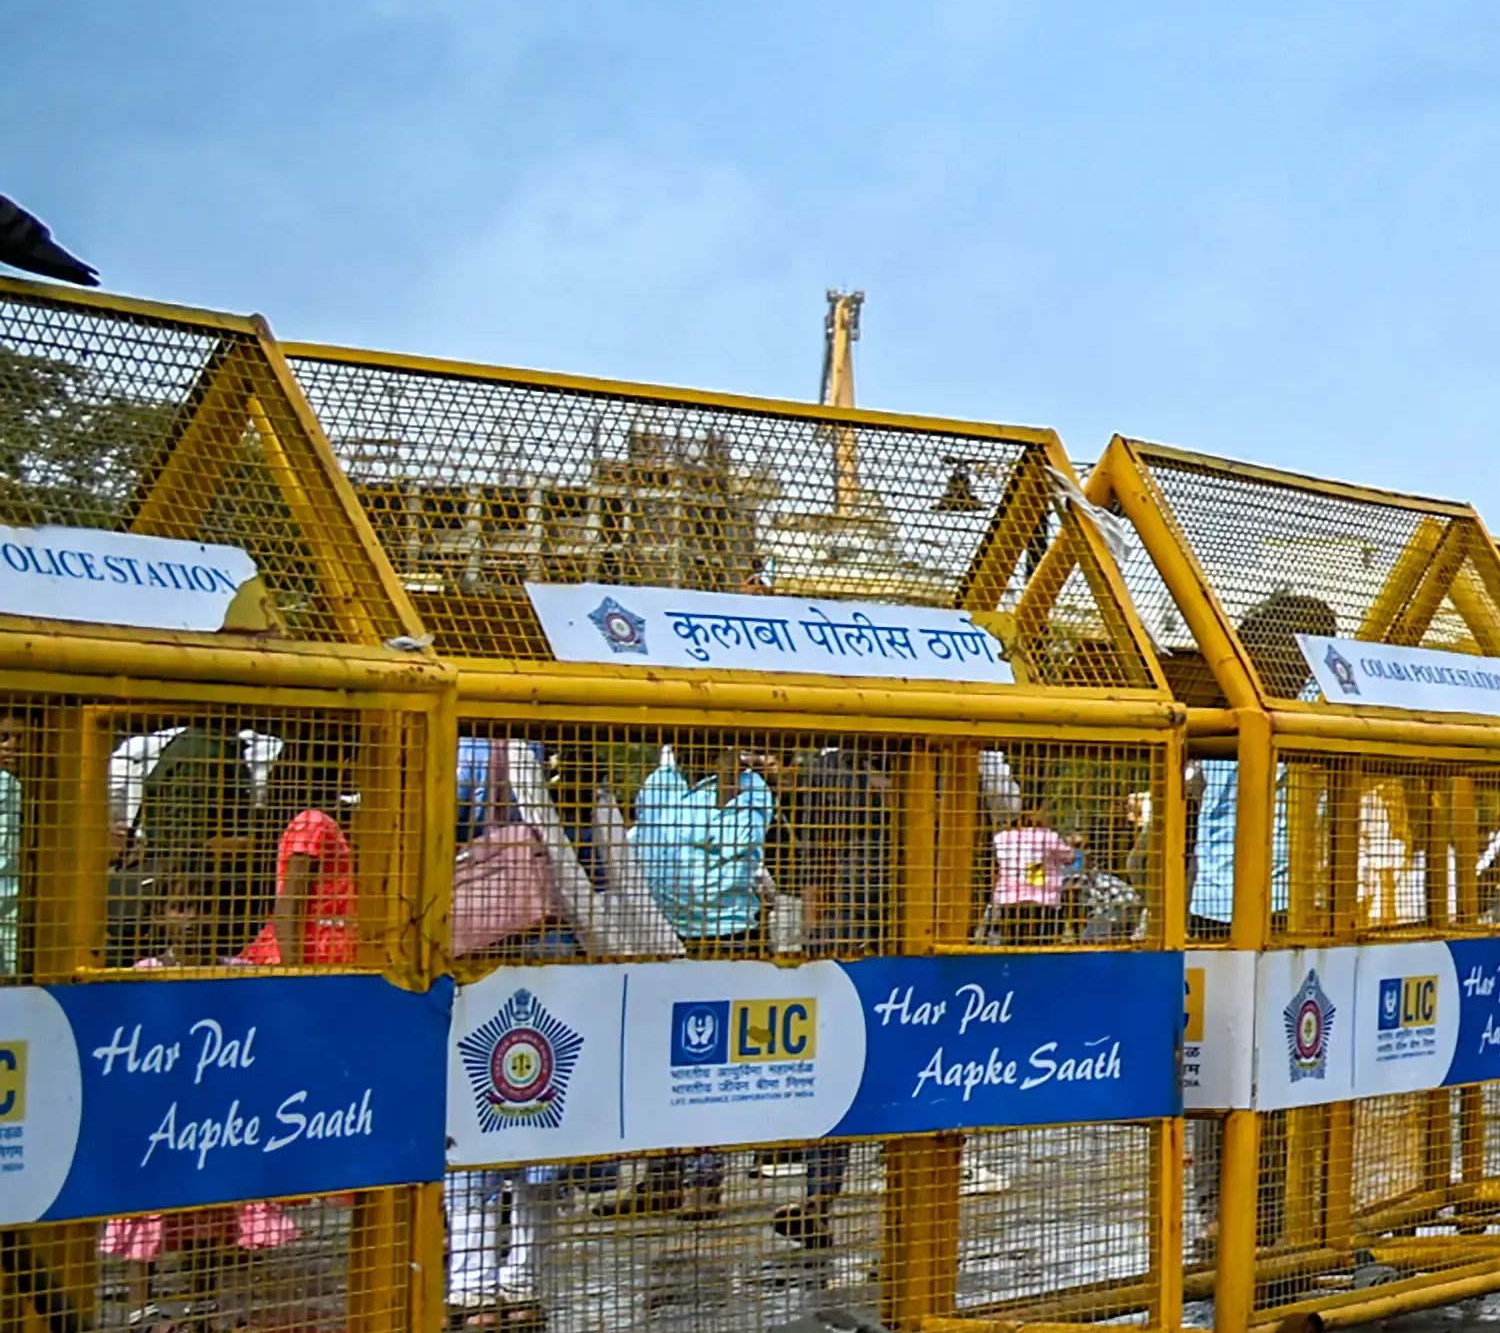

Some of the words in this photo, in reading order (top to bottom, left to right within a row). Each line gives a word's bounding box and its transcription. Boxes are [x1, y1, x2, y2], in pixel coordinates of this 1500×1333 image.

[0, 542, 104, 581] OLICE
[103, 554, 238, 594] STATION
[664, 611, 797, 662] कुलाबा
[799, 606, 918, 660] पोलीस
[919, 617, 995, 664] ठाणे
[1360, 657, 1411, 682] COLABA
[1411, 663, 1459, 687] POLICE
[1403, 979, 1434, 1023] LIC
[1463, 965, 1496, 997] Har
[738, 1004, 807, 1056] LIC
[874, 986, 946, 1026] Har
[956, 984, 1014, 1035] Pal
[93, 1024, 181, 1076] Har
[190, 1019, 257, 1084] Pal
[912, 1047, 1017, 1102] Aapke
[1020, 1041, 1121, 1090] Saath
[140, 1099, 260, 1170] Aapke
[263, 1089, 373, 1153] Saath
